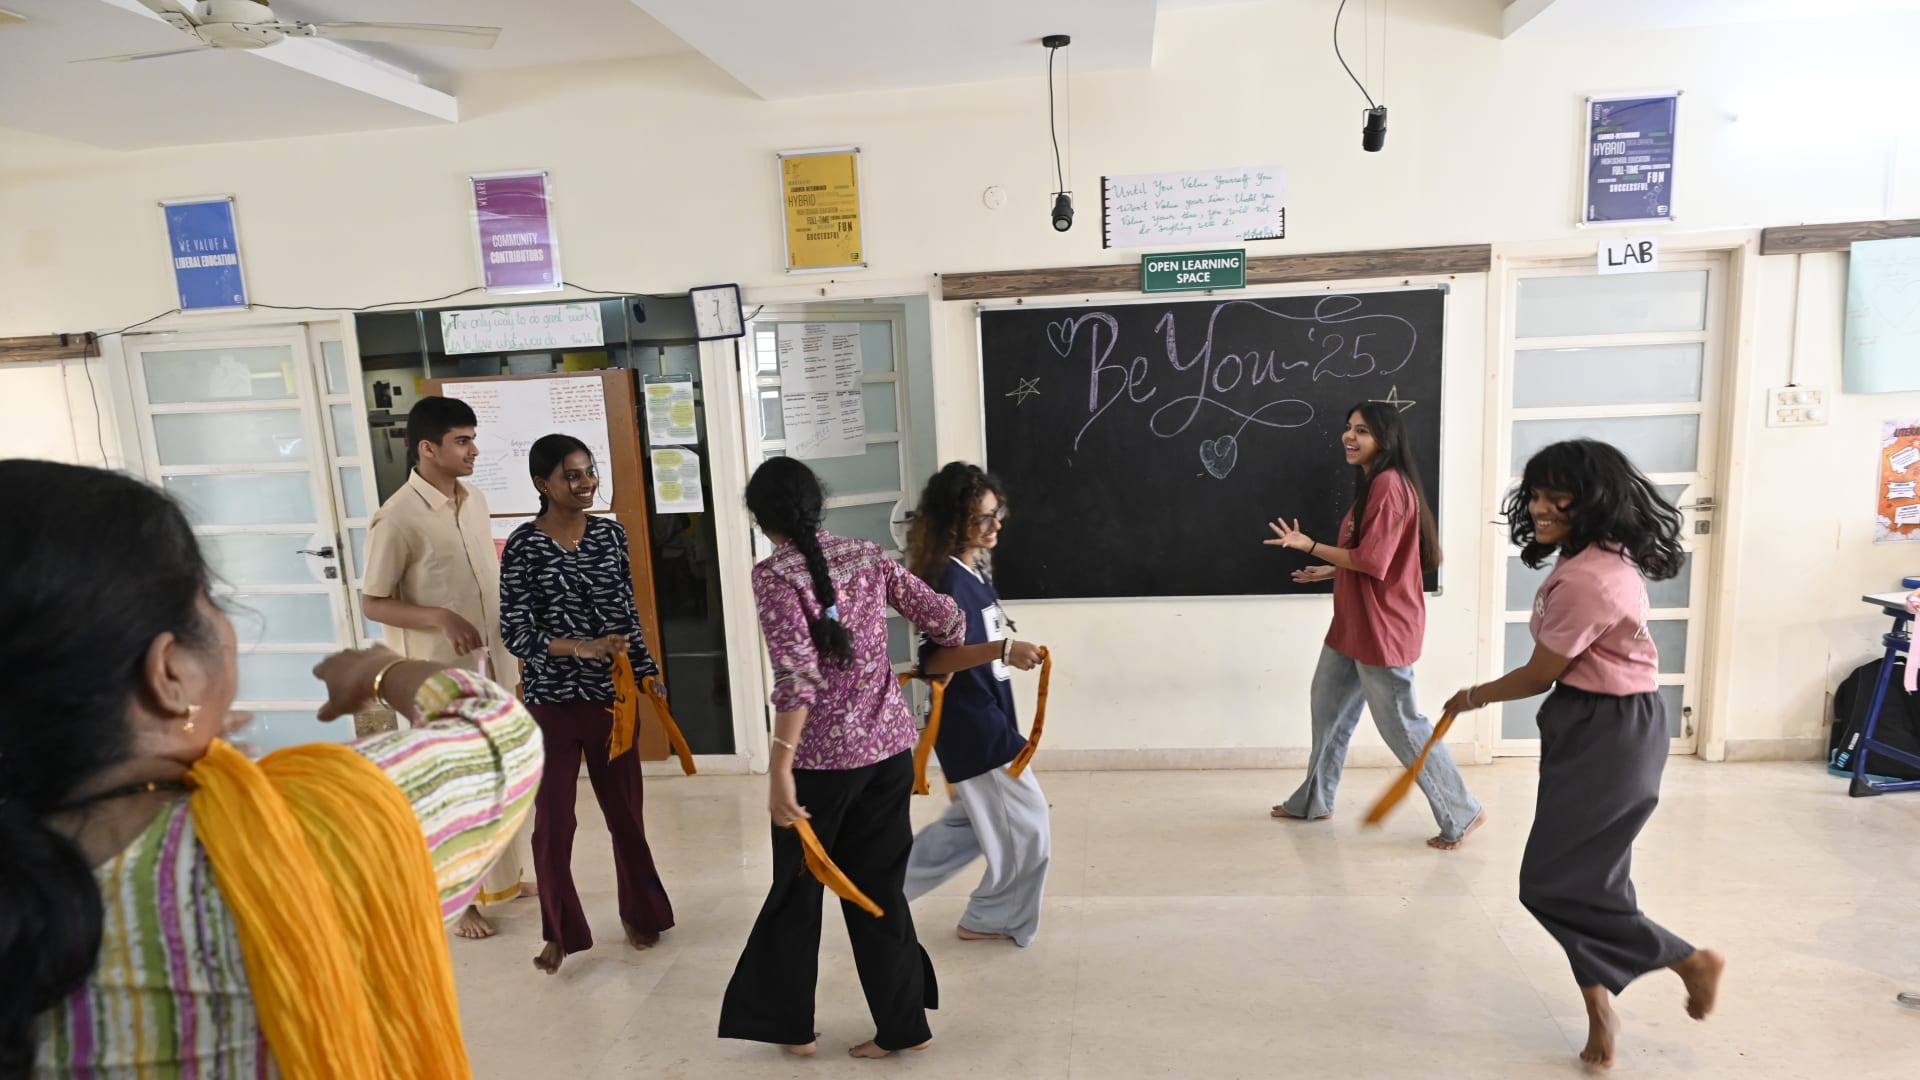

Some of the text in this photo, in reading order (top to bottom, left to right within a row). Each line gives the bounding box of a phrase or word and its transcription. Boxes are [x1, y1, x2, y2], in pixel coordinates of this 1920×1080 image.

[1593, 141, 1626, 156] HYBRID
[1612, 165, 1639, 175] FULL-TIME
[1647, 171, 1665, 183] FUN
[476, 182, 487, 195] ARE
[1112, 182, 1147, 198] Until
[1153, 180, 1173, 197] You
[1256, 173, 1272, 186] You
[1609, 182, 1648, 192] SUCCESSFUL
[788, 194, 816, 207] HYBRID
[838, 221, 853, 232] FUN
[492, 232, 538, 247] COMMUNITY
[806, 232, 839, 240] SUCCESSFUL
[178, 237, 229, 252] WE VALUE A
[174, 253, 237, 269] LIBERAL EDUCATION
[490, 249, 544, 264] CONTRIBUTORS
[1608, 241, 1653, 266] LAB
[1147, 257, 1240, 273] OPEN LEARNING
[1176, 272, 1211, 284] SPACE
[450, 313, 468, 330] The
[470, 314, 492, 331] only
[494, 317, 515, 330] way
[516, 310, 527, 325] to
[528, 311, 540, 324] do
[568, 306, 592, 322] work
[1072, 311, 1157, 450] Be
